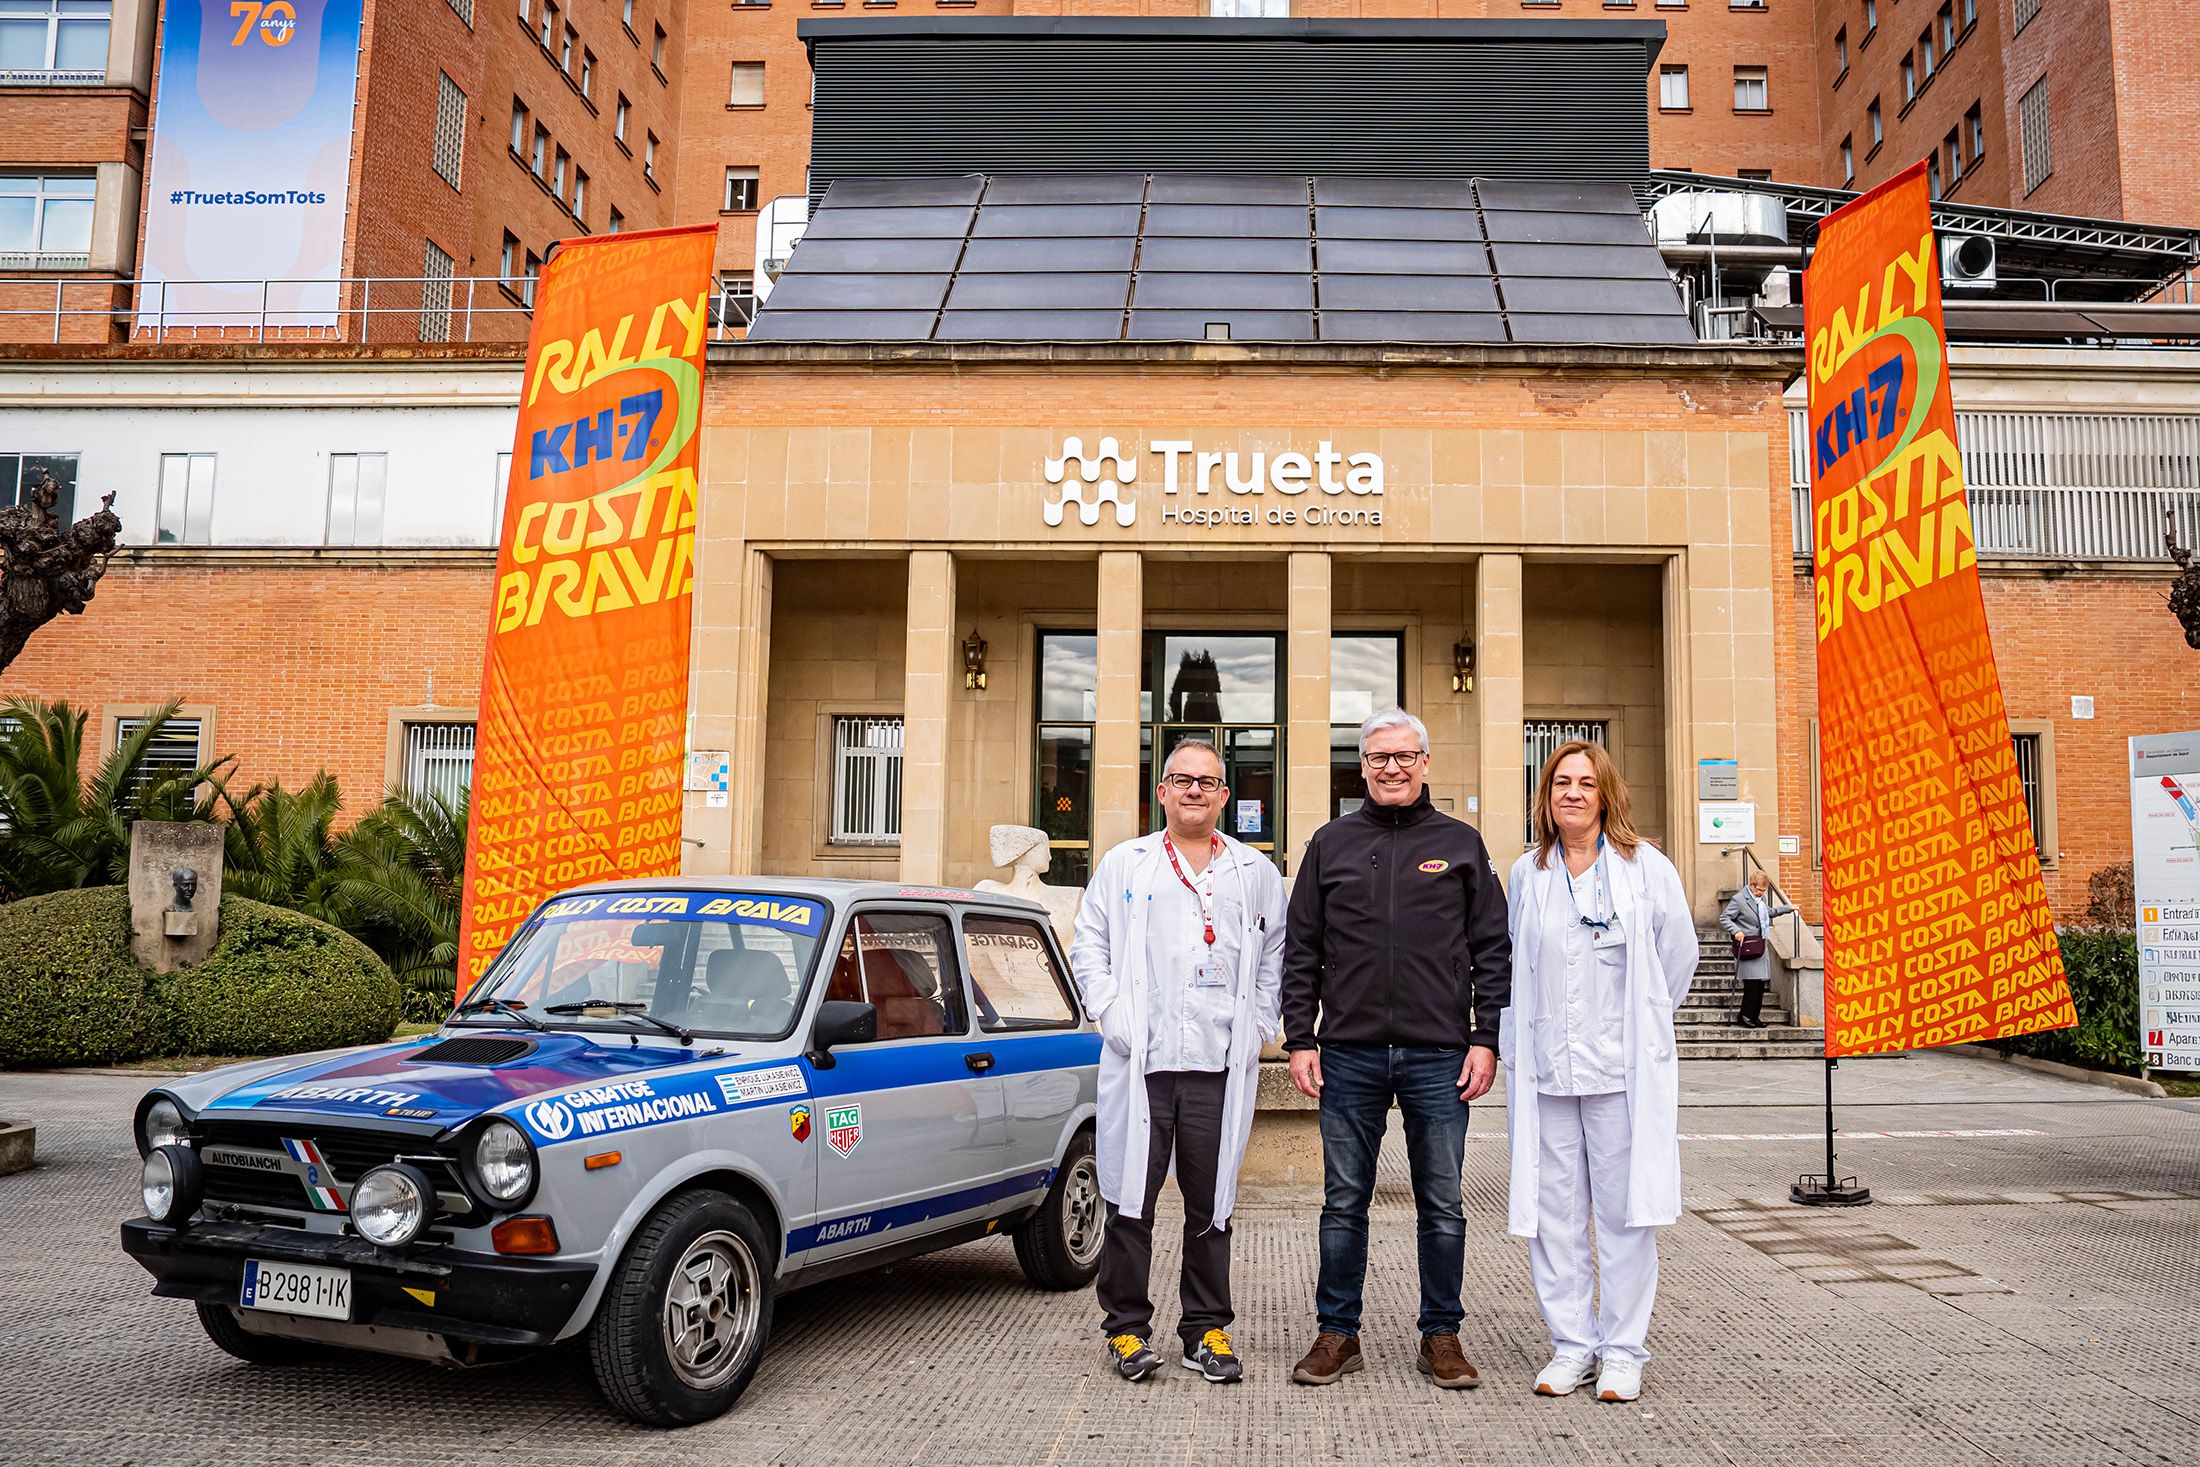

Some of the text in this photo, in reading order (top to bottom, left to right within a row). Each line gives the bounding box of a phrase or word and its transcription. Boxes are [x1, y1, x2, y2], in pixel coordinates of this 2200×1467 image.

[230, 0, 296, 46] 70
[260, 19, 296, 42] anys
[170, 190, 326, 205] #TruetaSomTots
[1811, 231, 1933, 408] RALLY
[528, 289, 708, 408] RALLY
[530, 389, 663, 480] KH-7
[1816, 353, 1904, 481] KH-7
[1150, 439, 1384, 497] Trueta
[512, 466, 698, 564] COSTA
[1161, 503, 1384, 528] Hospital de Girona
[1818, 427, 1965, 568] COSTA
[496, 532, 695, 634] BRAVA
[1817, 499, 1977, 644] BRAVA
[542, 701, 615, 731] COSTA
[620, 681, 687, 718] BRAV
[543, 673, 616, 703] COSTA
[622, 656, 688, 691] BRAV
[1864, 692, 1932, 733] COSTA
[1938, 662, 1997, 703] RAVA
[541, 728, 614, 757] COSTA
[619, 707, 686, 744] BRAV
[1868, 719, 1938, 761] COSTA
[1943, 691, 2004, 734] RAVA
[541, 754, 614, 783] COSTA
[618, 736, 684, 771] BRAV
[1873, 747, 1944, 789] COSTA
[478, 815, 540, 845] RALLY
[617, 788, 683, 823] BRAV
[480, 789, 540, 819] RALLY
[618, 763, 683, 797] BRAV
[1826, 800, 1872, 836] RALLY
[1877, 776, 1949, 816] COSTA
[476, 841, 540, 871] RALLY
[545, 832, 612, 858] COSTA
[1827, 827, 1876, 863] RALLY
[1882, 803, 1955, 844] COSTA
[474, 867, 539, 898] RALLY
[544, 853, 615, 884] COSTA
[1829, 854, 1880, 890] RALLY
[1887, 831, 1961, 871] COSTA
[473, 894, 538, 924] RALLY
[535, 897, 811, 926] RALLY COSTA BRAVA
[1831, 882, 1884, 917] RALLY
[1891, 859, 1967, 898] COSTA
[1832, 908, 1889, 944] RALLY
[1896, 885, 1972, 926] COSTA
[1833, 933, 1893, 969] RALLY
[1900, 911, 1976, 952] COSTA
[2148, 910, 2154, 921] 1
[1835, 962, 1898, 996] RALLY
[1904, 938, 1980, 978] COSTA
[1836, 989, 1902, 1022] RALLY
[1908, 963, 1984, 1004] COSTA
[1836, 955, 2064, 1047] RALLY COSTA BRAVA
[1912, 1012, 1990, 1048] COSTA
[1995, 980, 2070, 1023] BRAVA
[2152, 1054, 2160, 1066] 8
[2167, 1053, 2192, 1066] Banc
[269, 1086, 421, 1108] ABARTH
[564, 1081, 656, 1108] GARATGE
[576, 1091, 717, 1135] INTERNACIONAL
[829, 1111, 858, 1127] TAG
[212, 1152, 282, 1171] AUTOBIANCHI
[830, 1128, 859, 1151] HEUER
[816, 1216, 871, 1242] ABARTH
[246, 1287, 253, 1298] E
